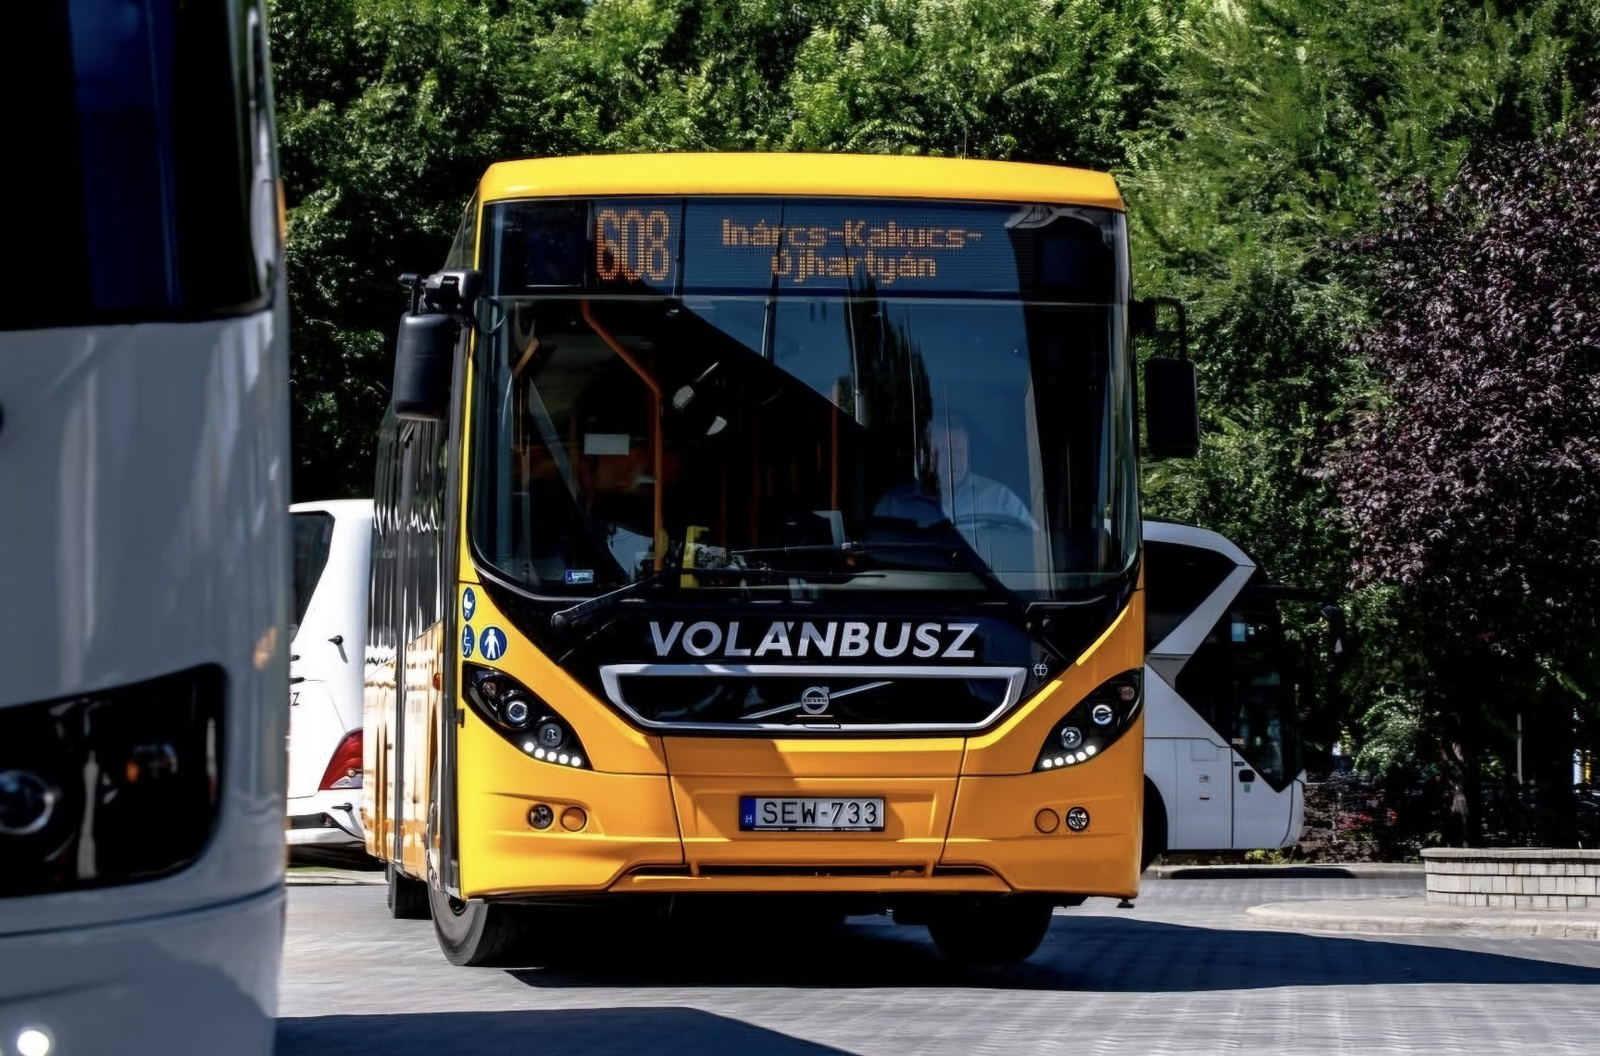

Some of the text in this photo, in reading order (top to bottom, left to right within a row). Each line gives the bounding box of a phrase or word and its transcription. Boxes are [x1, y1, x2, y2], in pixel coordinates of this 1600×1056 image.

[597, 209, 669, 280] 608
[650, 621, 979, 658] VOLÁNBUSZ
[762, 801, 877, 824] SEW-733
